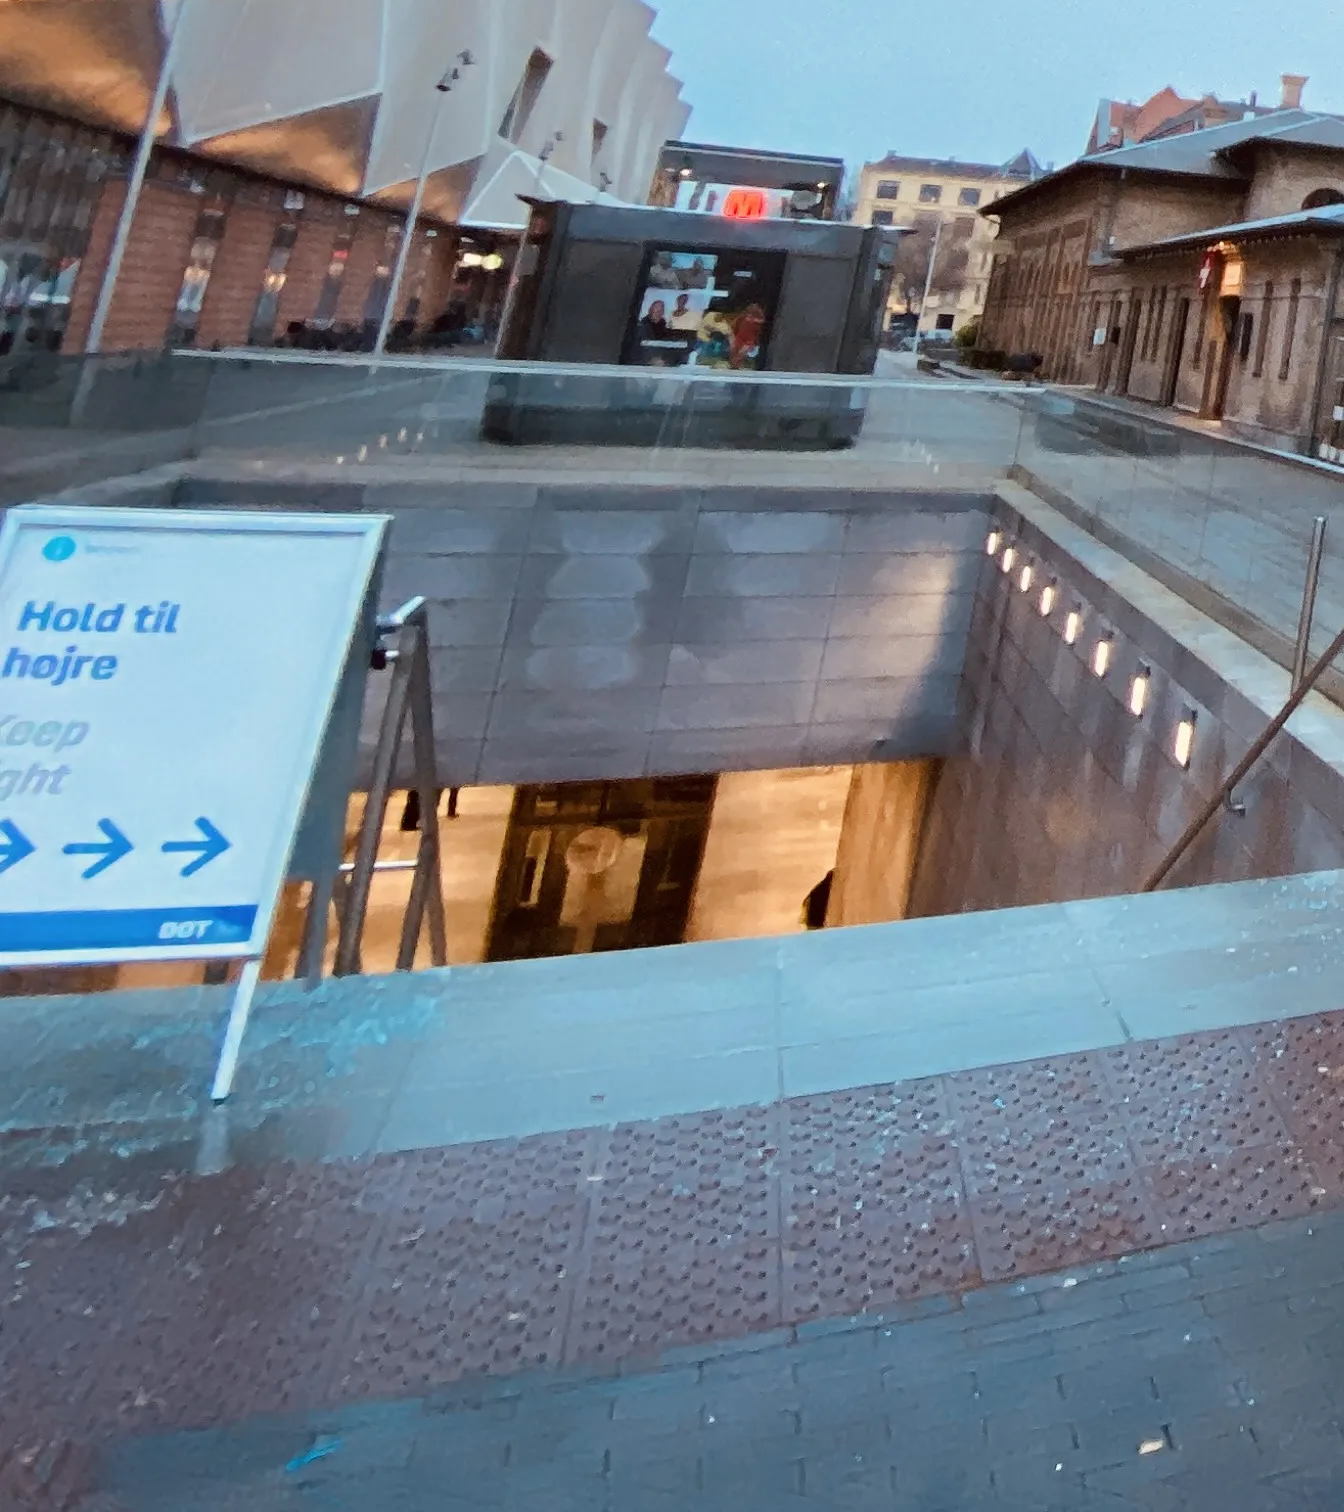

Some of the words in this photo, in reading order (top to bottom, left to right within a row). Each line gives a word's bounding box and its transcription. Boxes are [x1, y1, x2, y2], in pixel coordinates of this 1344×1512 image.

[725, 190, 764, 218] M
[17, 600, 126, 632] Hold
[134, 600, 181, 633] til
[1, 645, 118, 686] højre
[0, 761, 71, 801] ght
[158, 919, 213, 939] DOT
